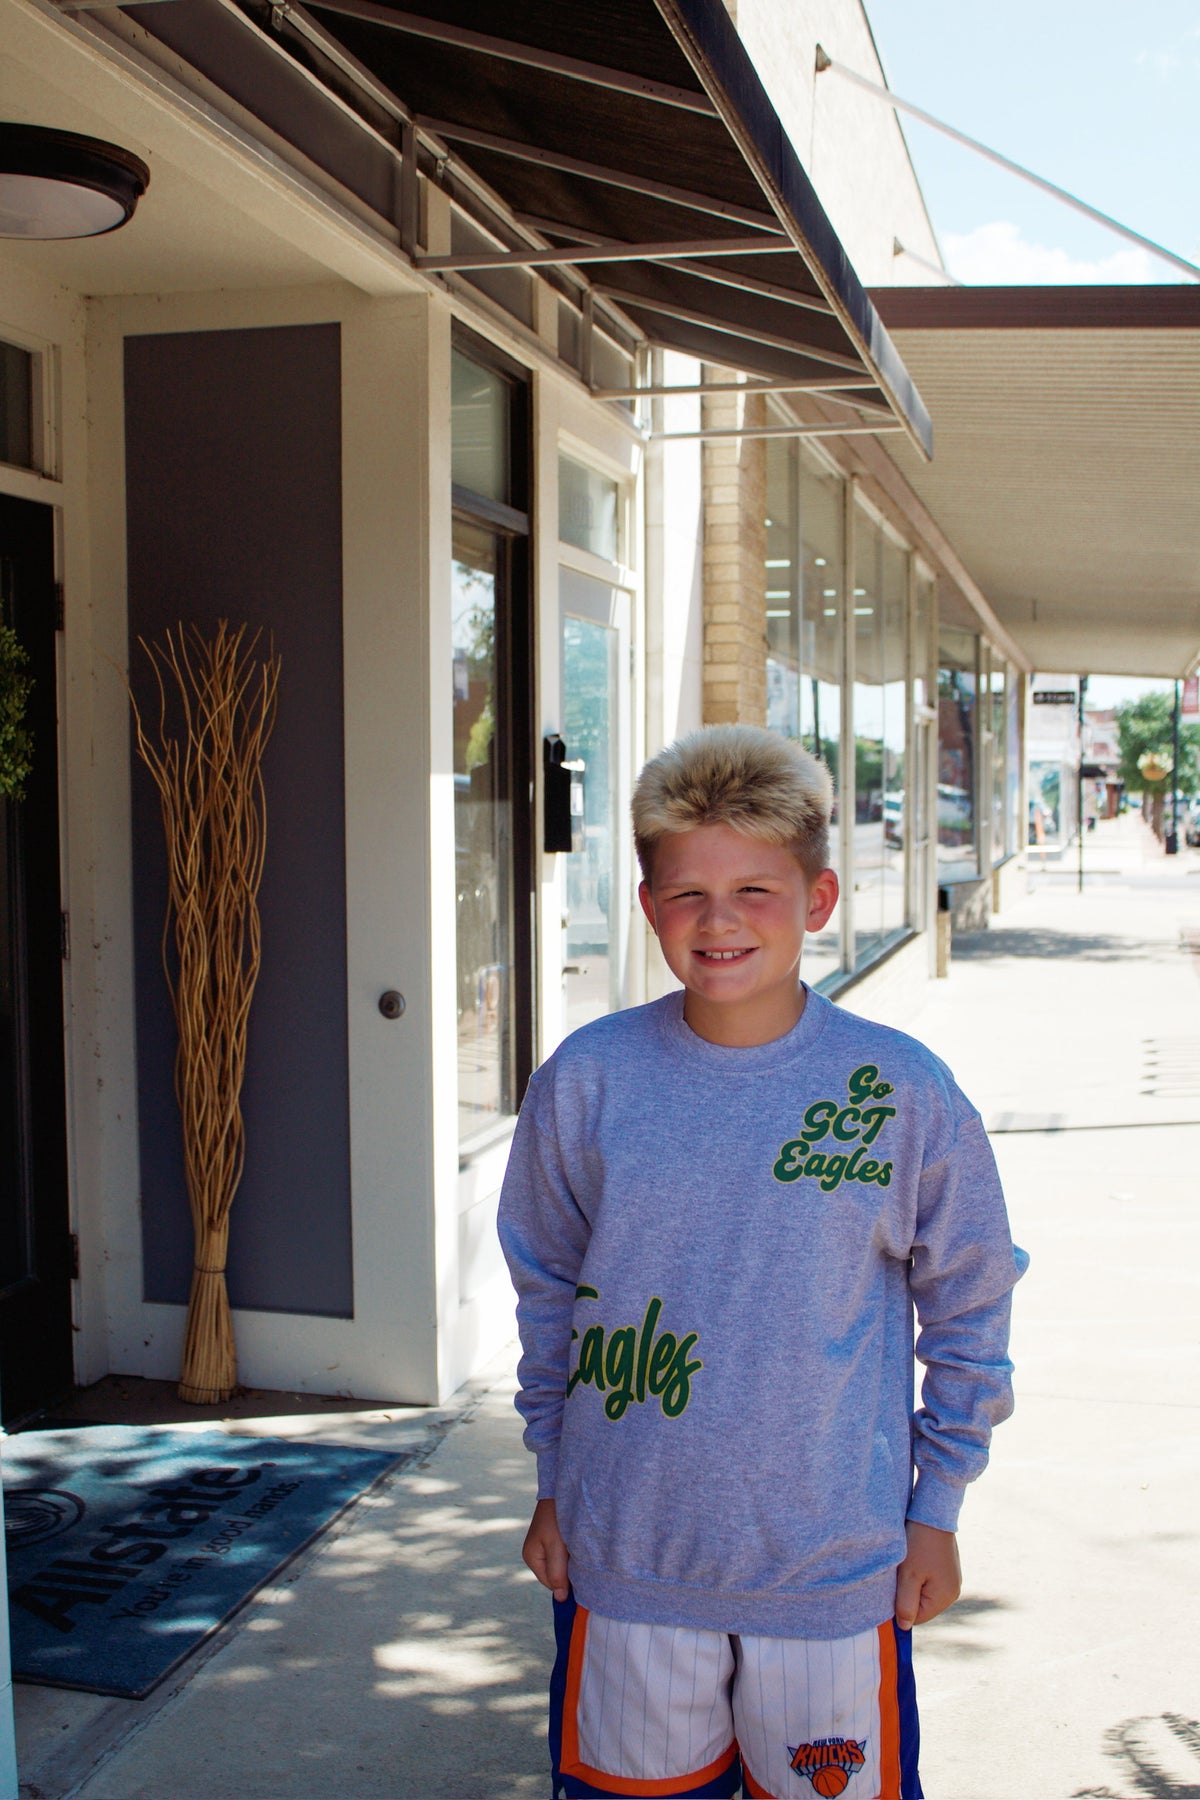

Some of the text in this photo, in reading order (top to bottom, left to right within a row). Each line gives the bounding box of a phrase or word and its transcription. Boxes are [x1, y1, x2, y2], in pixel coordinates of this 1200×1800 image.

[848, 1064, 894, 1105] Go
[772, 1139, 893, 1192] Eagles
[565, 1284, 703, 1420] agles
[11, 1467, 262, 1633] Allstate
[200, 1519, 253, 1555] good
[790, 1740, 866, 1773] KNICKS
